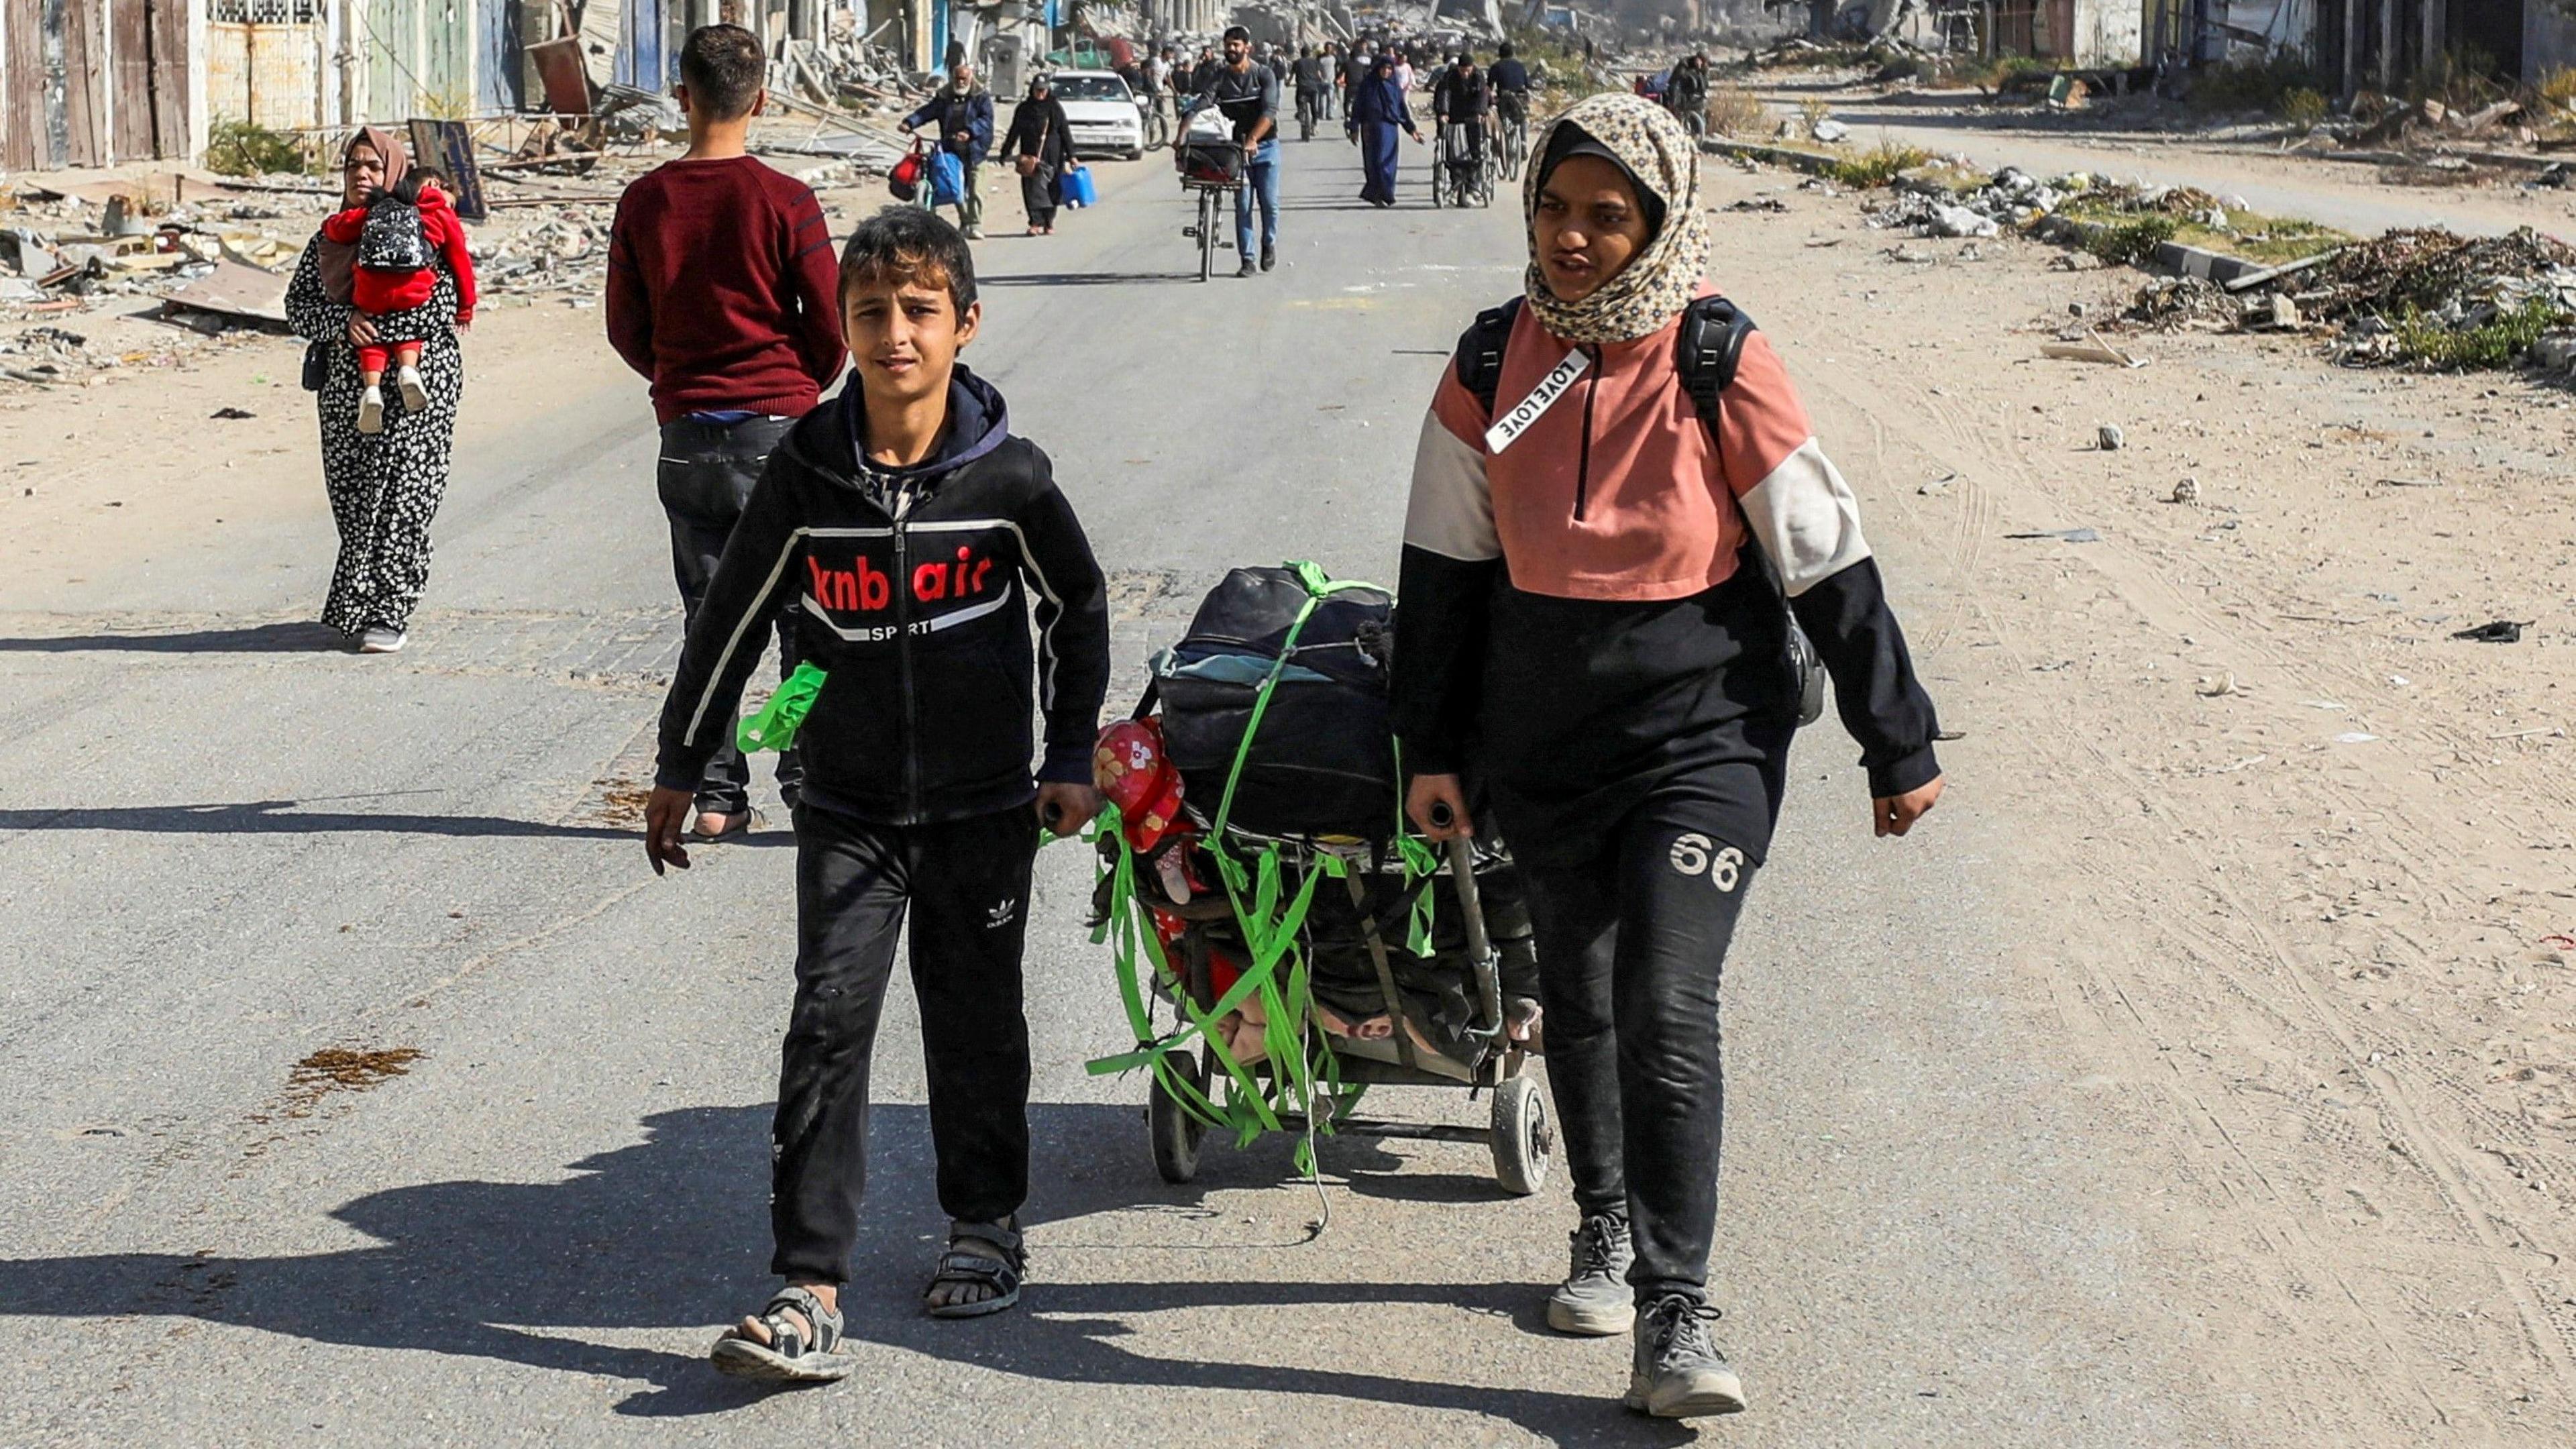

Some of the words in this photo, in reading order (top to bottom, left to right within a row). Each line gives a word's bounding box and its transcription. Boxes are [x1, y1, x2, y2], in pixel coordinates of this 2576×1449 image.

[1533, 361, 1576, 404] LOVE
[1499, 400, 1540, 438] LOVE
[807, 555, 890, 611] knb
[913, 546, 993, 602] air
[871, 620, 932, 641] SPRT
[1670, 833, 1745, 893] 66
